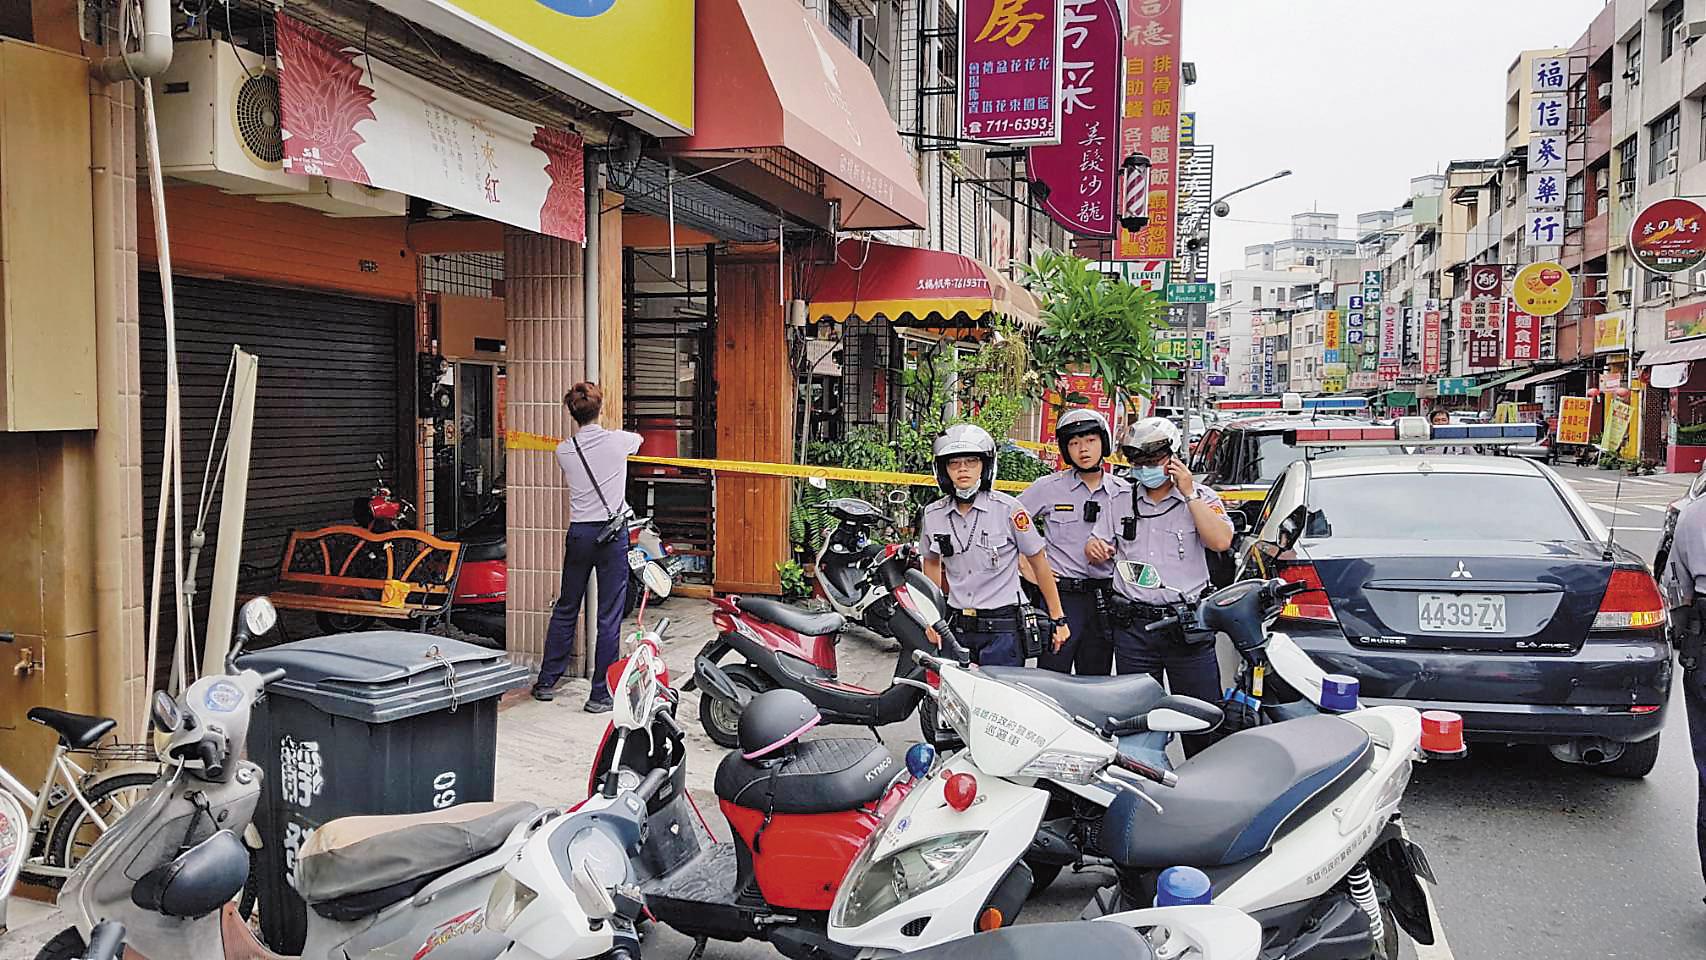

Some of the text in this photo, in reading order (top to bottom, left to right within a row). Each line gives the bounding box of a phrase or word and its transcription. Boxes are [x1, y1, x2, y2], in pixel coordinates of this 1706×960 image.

[1125, 57, 1144, 118] 自助餐
[1152, 55, 1172, 117] 排骨飯
[985, 117, 1048, 133] 711-6393
[1077, 121, 1107, 223] 美髮沙龍
[1642, 217, 1701, 235] 茶の魔手
[1383, 319, 1394, 351] YAMAHA
[864, 756, 893, 783] KYMCO
